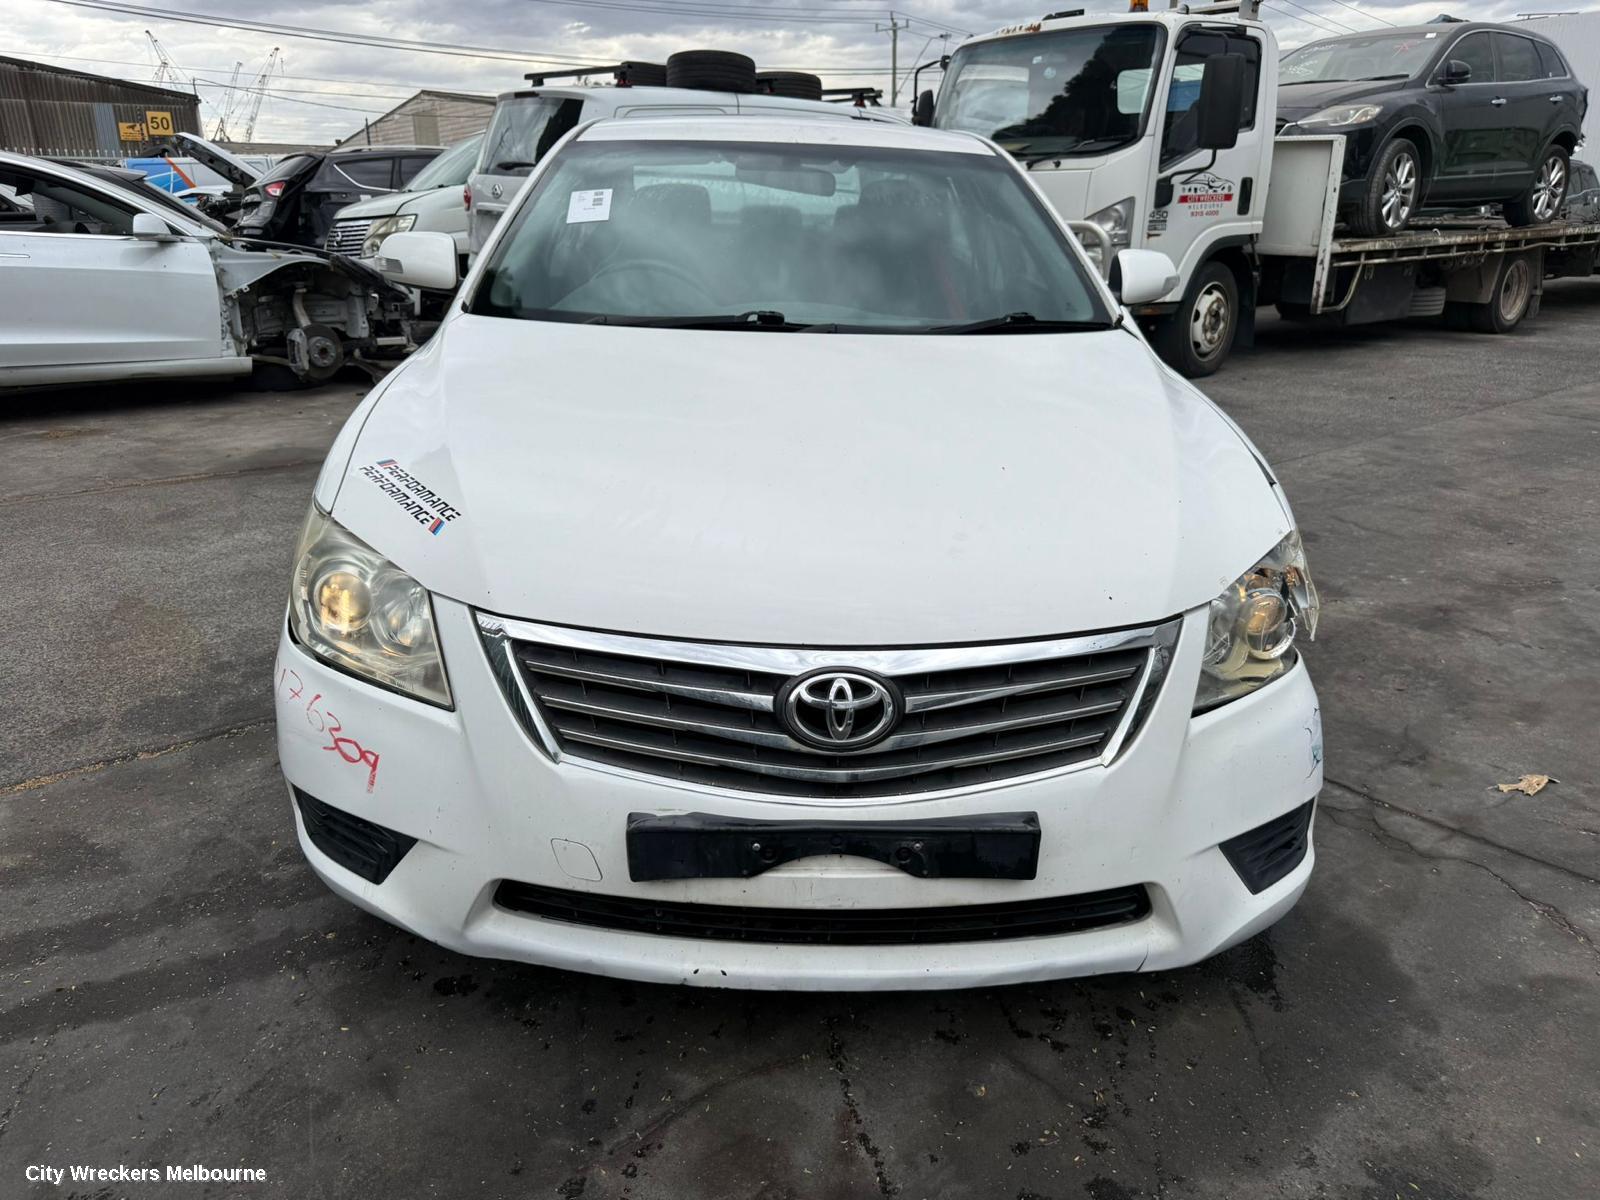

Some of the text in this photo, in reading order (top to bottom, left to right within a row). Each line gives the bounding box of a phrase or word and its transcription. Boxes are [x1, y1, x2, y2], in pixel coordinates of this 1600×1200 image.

[150, 116, 170, 130] 50
[1149, 210, 1168, 219] 450
[359, 465, 435, 525] PERFORMANCE
[384, 464, 461, 521] PERFORMANCE
